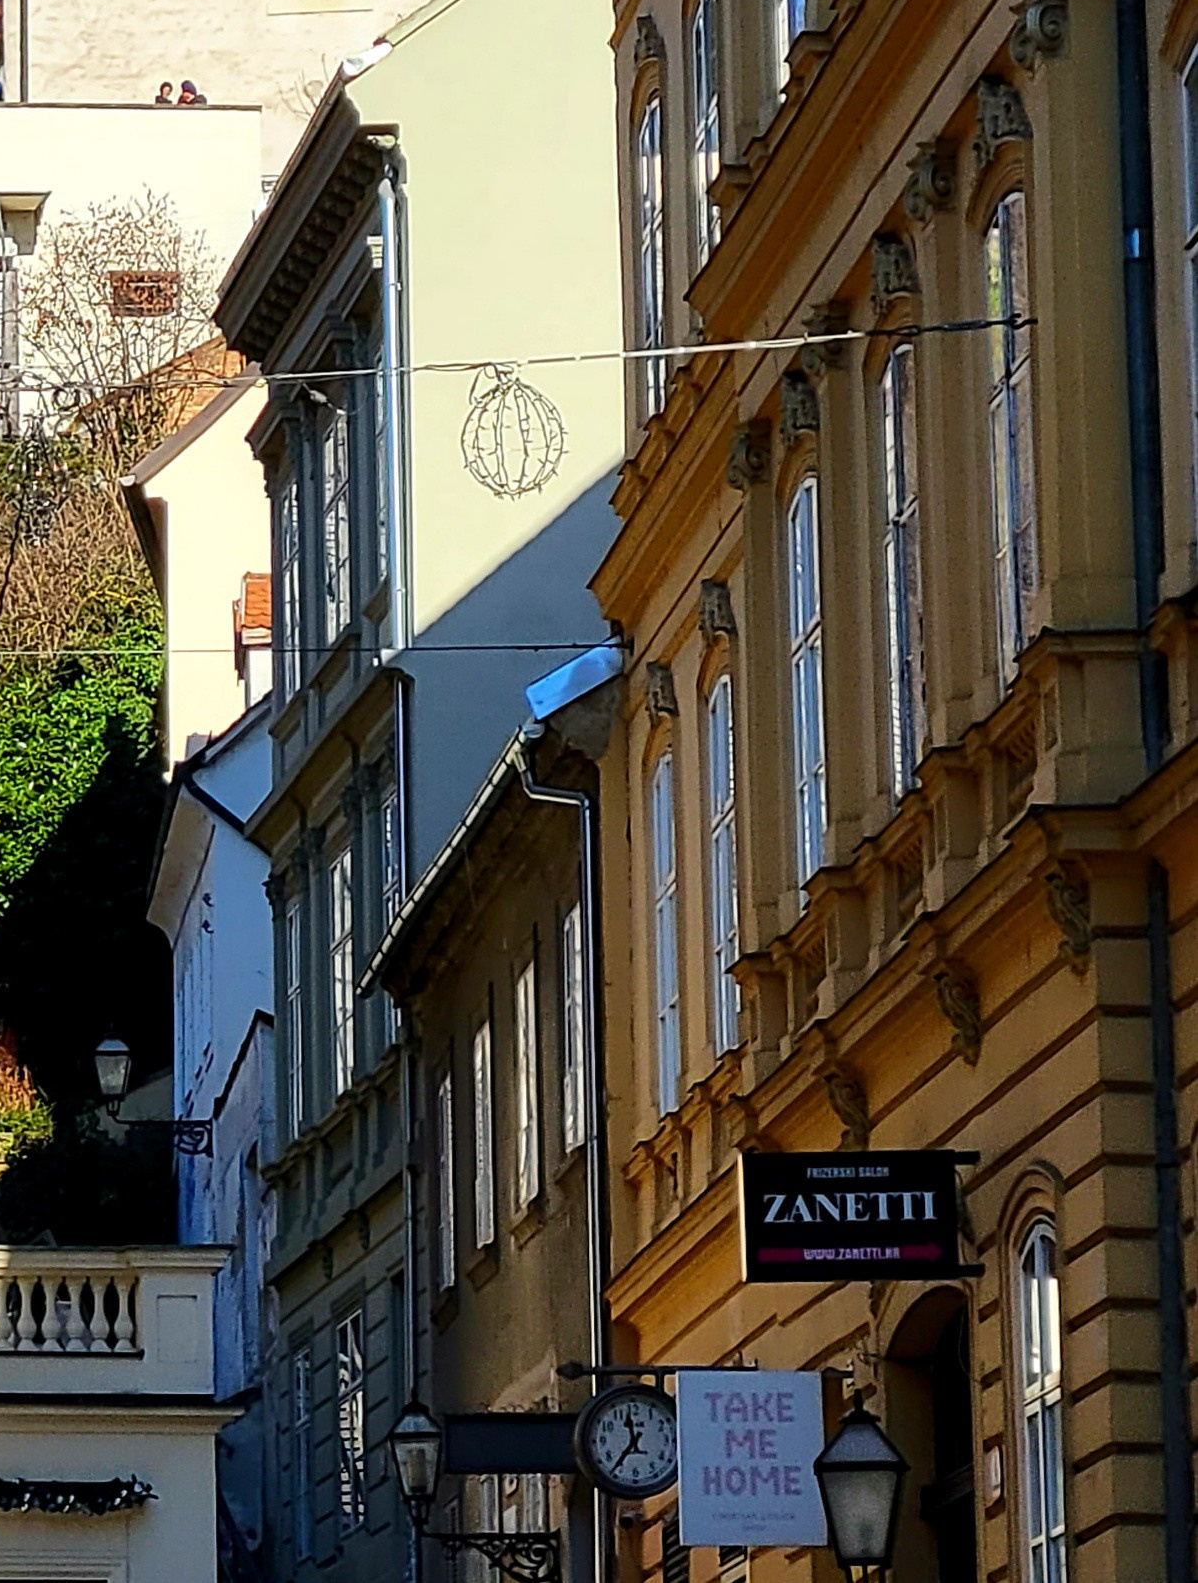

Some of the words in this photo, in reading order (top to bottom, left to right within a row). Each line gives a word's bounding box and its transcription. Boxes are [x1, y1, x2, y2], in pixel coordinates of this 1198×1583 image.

[859, 1166, 890, 1178] SALON
[763, 1191, 938, 1223] ZANETTI
[704, 1392, 796, 1423] TAKE
[725, 1429, 777, 1459] ME
[703, 1466, 801, 1496] HOME
